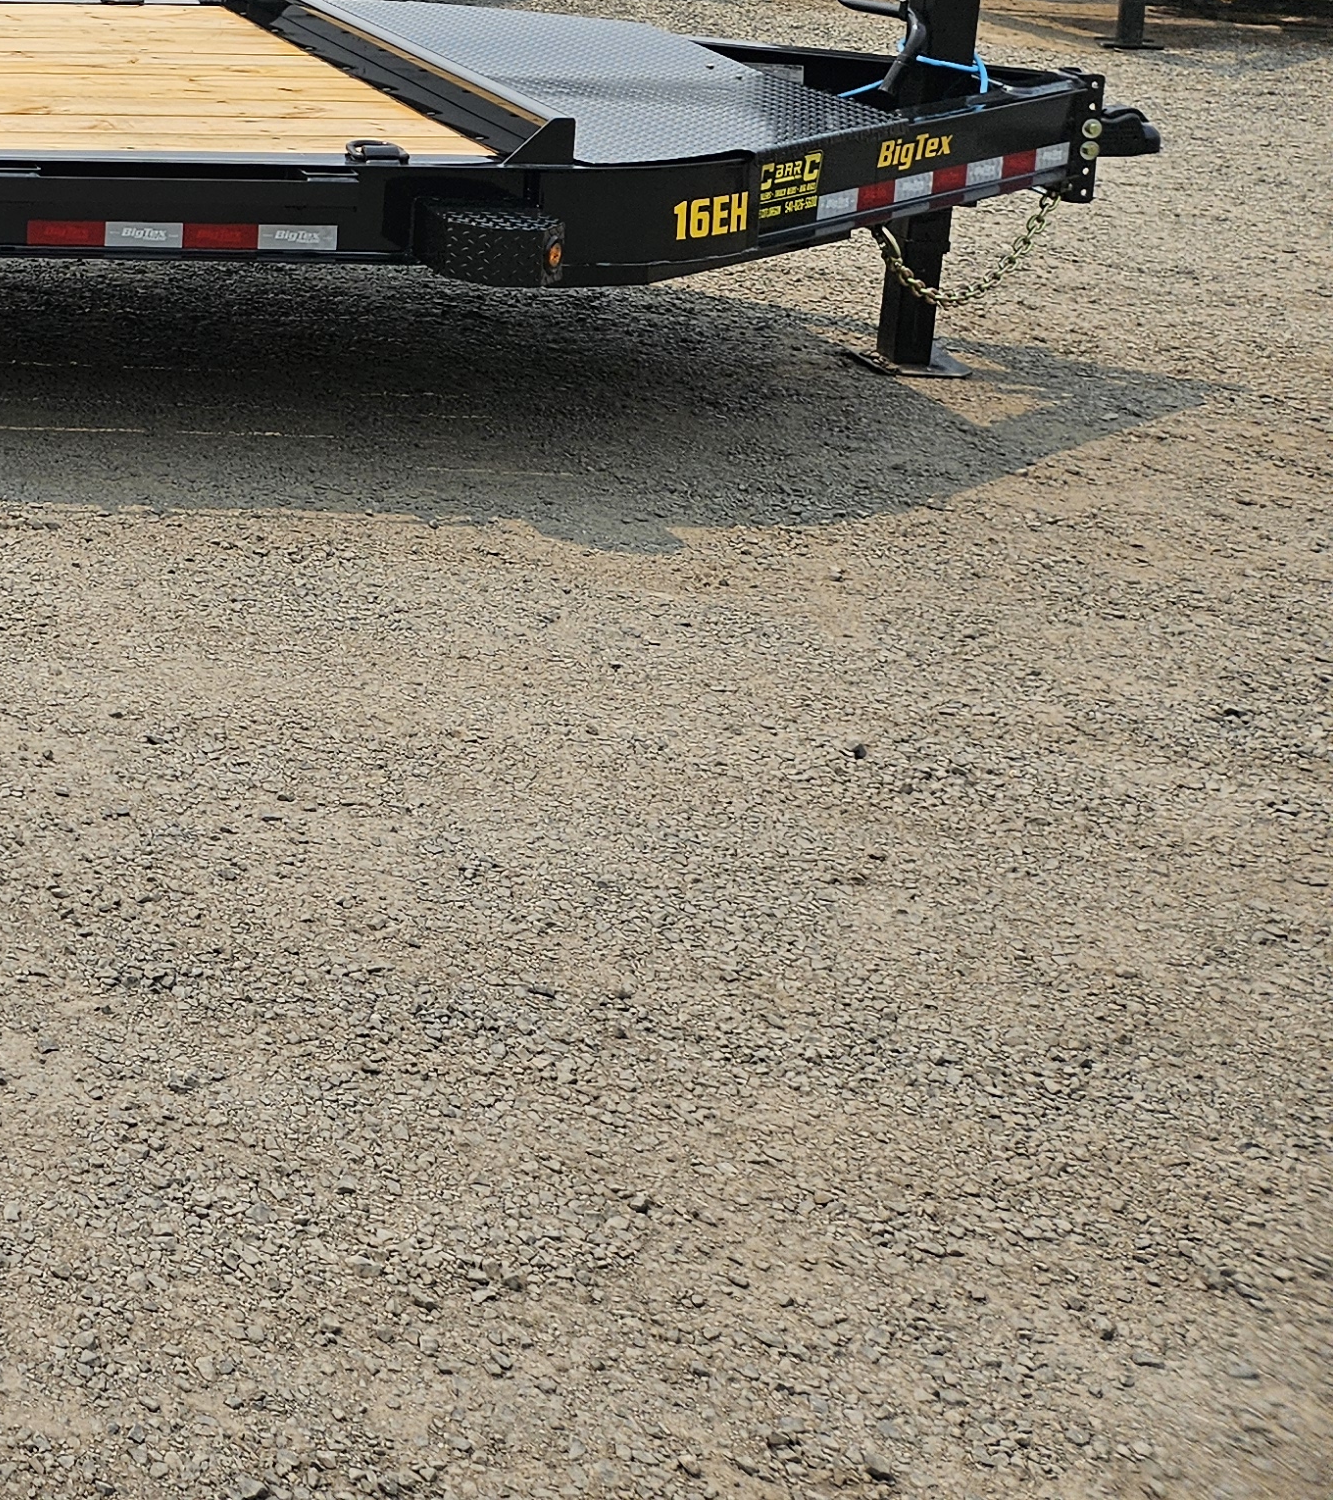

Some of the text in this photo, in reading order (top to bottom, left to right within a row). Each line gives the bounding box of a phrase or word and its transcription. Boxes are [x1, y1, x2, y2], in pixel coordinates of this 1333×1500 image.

[876, 133, 953, 171] BigTex
[673, 191, 749, 240] 16EH
[121, 227, 165, 239] BigTex
[274, 230, 319, 242] BigTex
